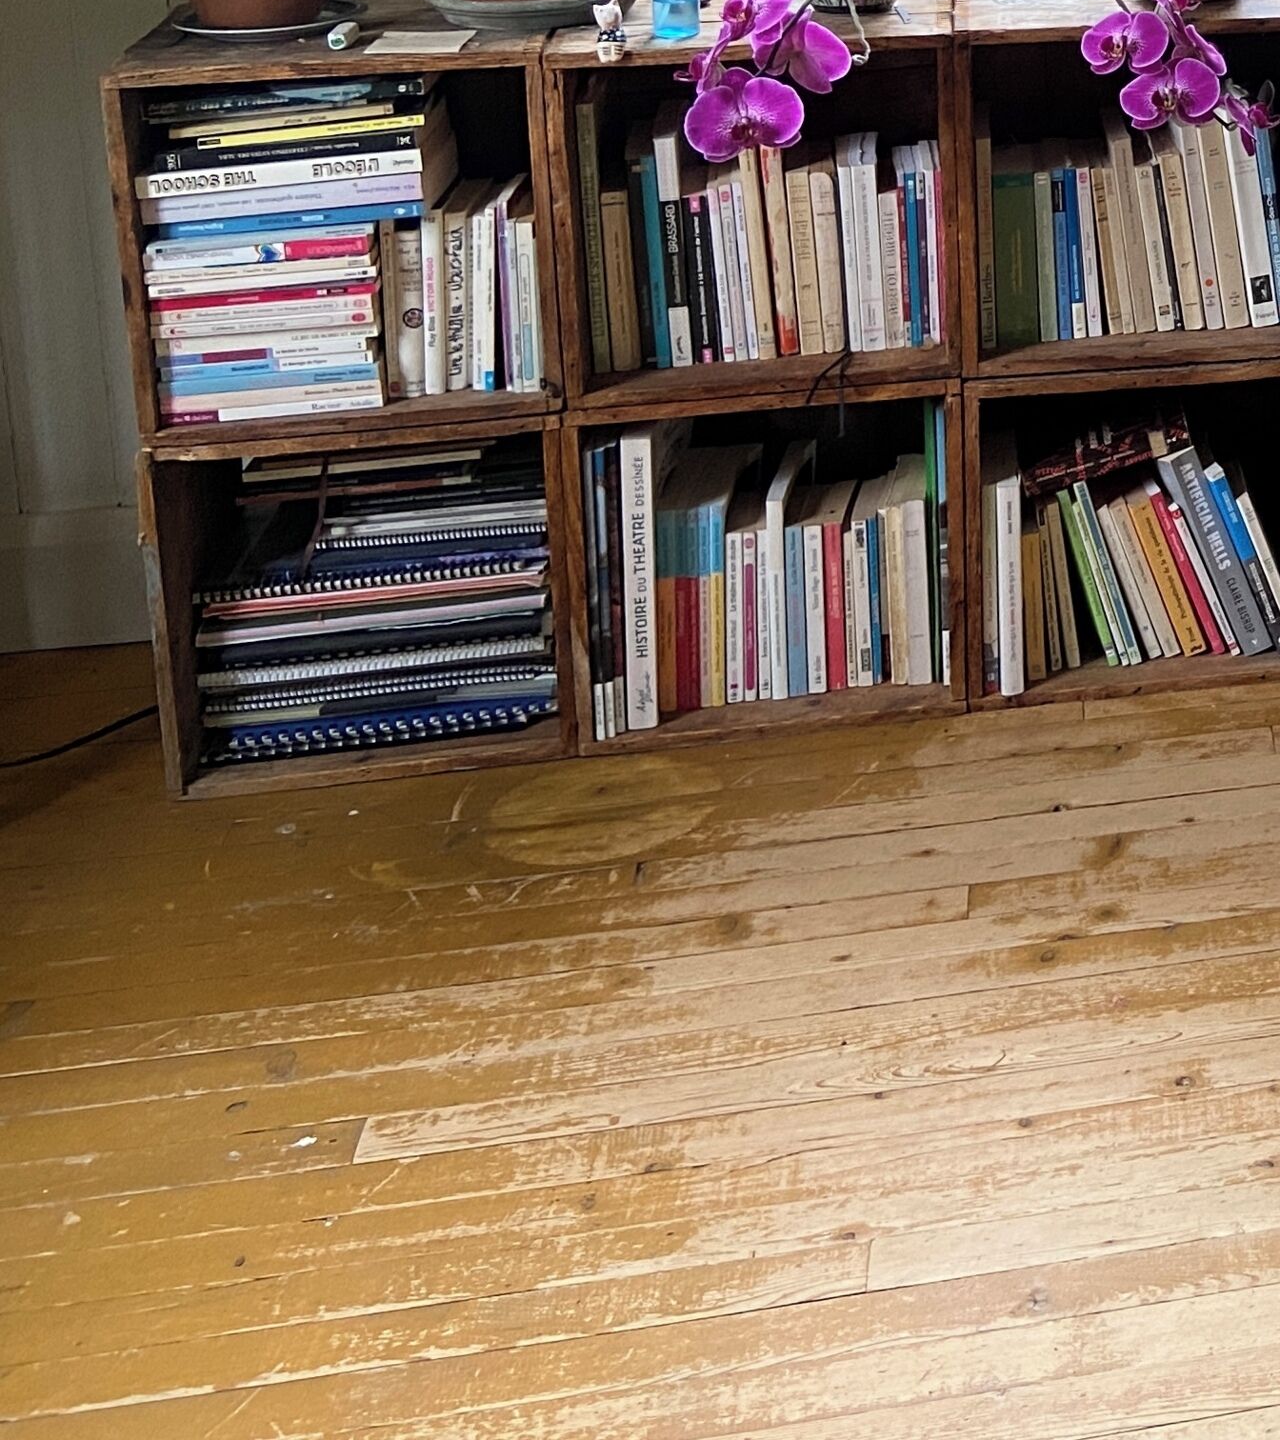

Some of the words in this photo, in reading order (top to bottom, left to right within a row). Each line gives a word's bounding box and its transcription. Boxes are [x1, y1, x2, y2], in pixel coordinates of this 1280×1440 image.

[149, 173, 221, 195] SCHOOL
[223, 171, 257, 187] THE
[312, 158, 380, 178] L'ÉCOLE
[665, 204, 679, 254] BRASSARD
[426, 256, 434, 281] HUGO
[427, 283, 435, 313] VICTOR
[633, 455, 645, 508] DESSINÉE
[1179, 462, 1216, 532] ARTIFICIAL
[1206, 530, 1232, 572] HELLS
[631, 512, 646, 575] THEATRE
[636, 576, 647, 594] DU
[1225, 576, 1245, 607] CLAIRE
[1236, 603, 1257, 635] BISHOP
[635, 595, 649, 659] HISTOIRE
